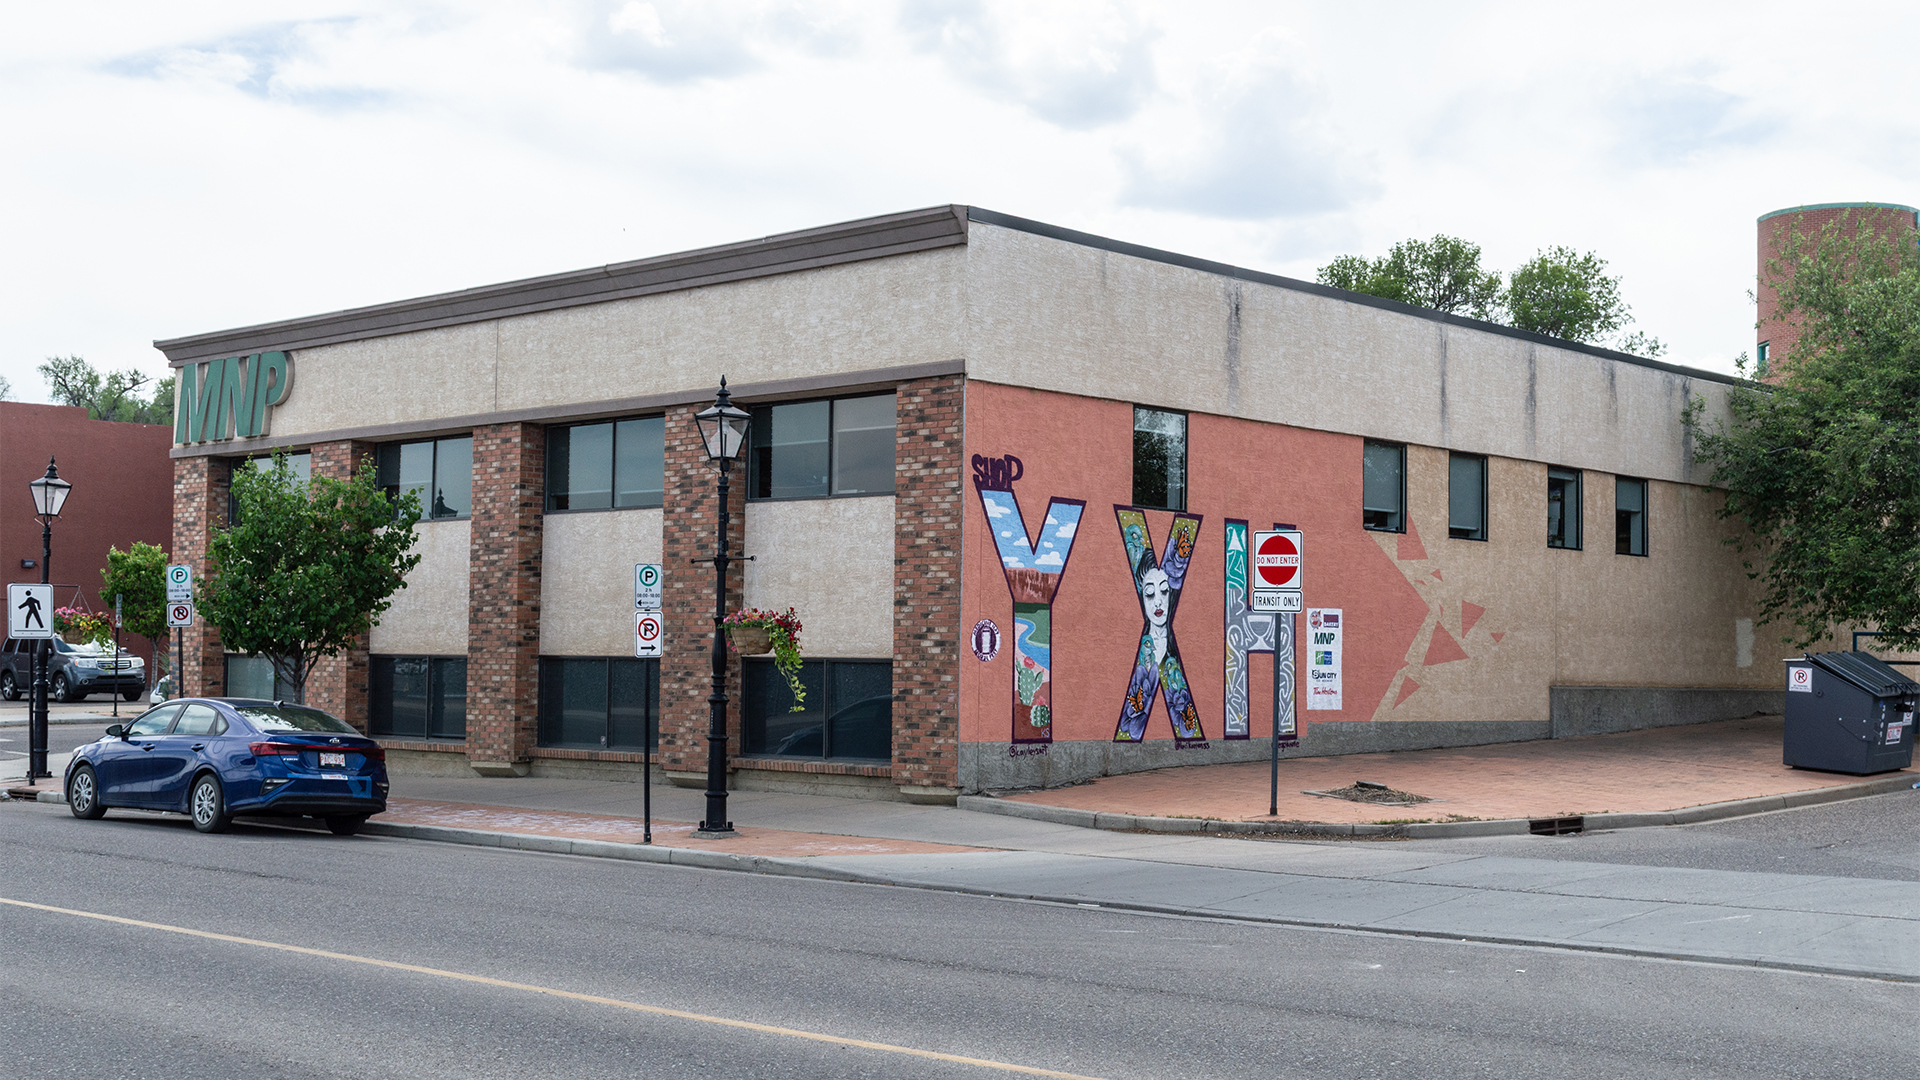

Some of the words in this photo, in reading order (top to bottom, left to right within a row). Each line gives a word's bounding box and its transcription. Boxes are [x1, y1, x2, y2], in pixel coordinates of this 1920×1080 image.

[175, 351, 290, 443] MNP
[972, 454, 1023, 489] SHOP
[176, 571, 183, 580] P
[645, 571, 653, 581] P
[1255, 596, 1280, 606] TRANSIT
[1283, 596, 1300, 607] ONLY
[1314, 632, 1335, 644] MNP
[1312, 670, 1326, 680] SUN
[1041, 728, 1050, 738] KS
